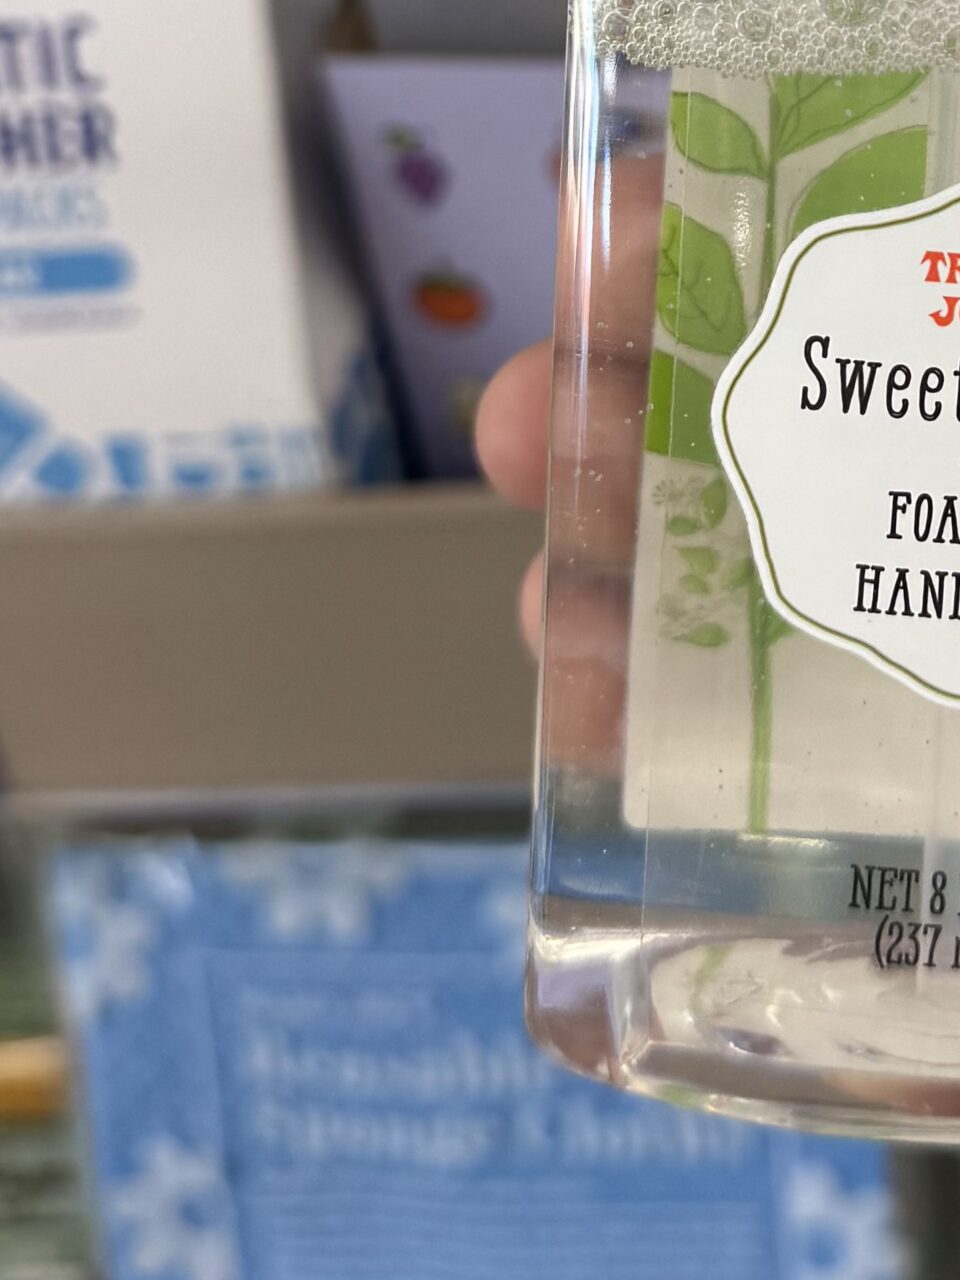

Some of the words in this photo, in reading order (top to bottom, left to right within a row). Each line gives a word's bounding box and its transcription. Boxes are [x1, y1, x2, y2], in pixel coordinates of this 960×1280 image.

[848, 863, 919, 912] NET
[929, 871, 948, 915] 8
[874, 914, 943, 969] (237
